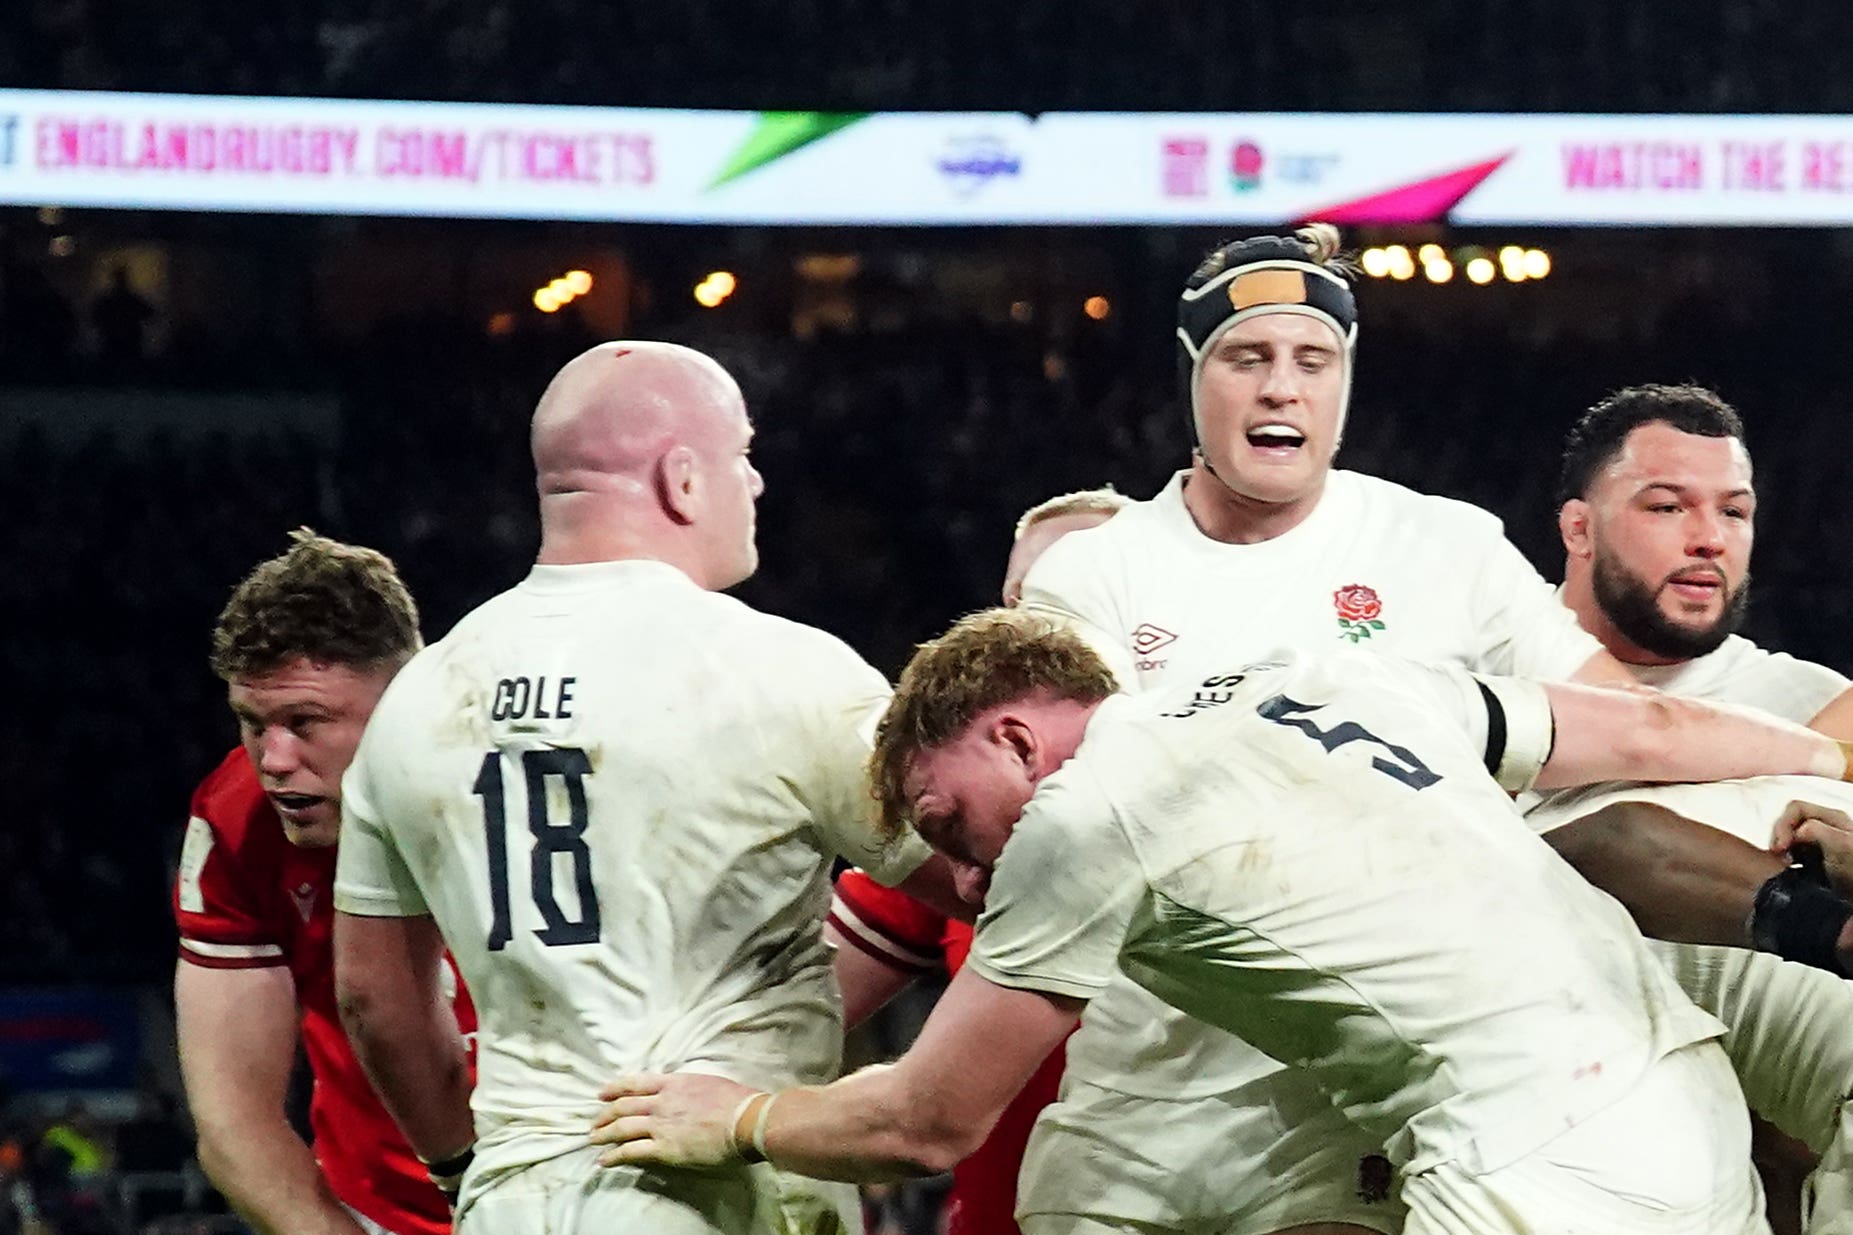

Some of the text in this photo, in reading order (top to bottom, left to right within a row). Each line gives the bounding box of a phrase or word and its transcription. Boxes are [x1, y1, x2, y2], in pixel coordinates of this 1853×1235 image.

[1562, 141, 1703, 190] WATCH
[1721, 141, 1786, 190] THE
[492, 675, 577, 721] COLE
[1256, 693, 1444, 791] 5
[472, 747, 602, 952] 18
